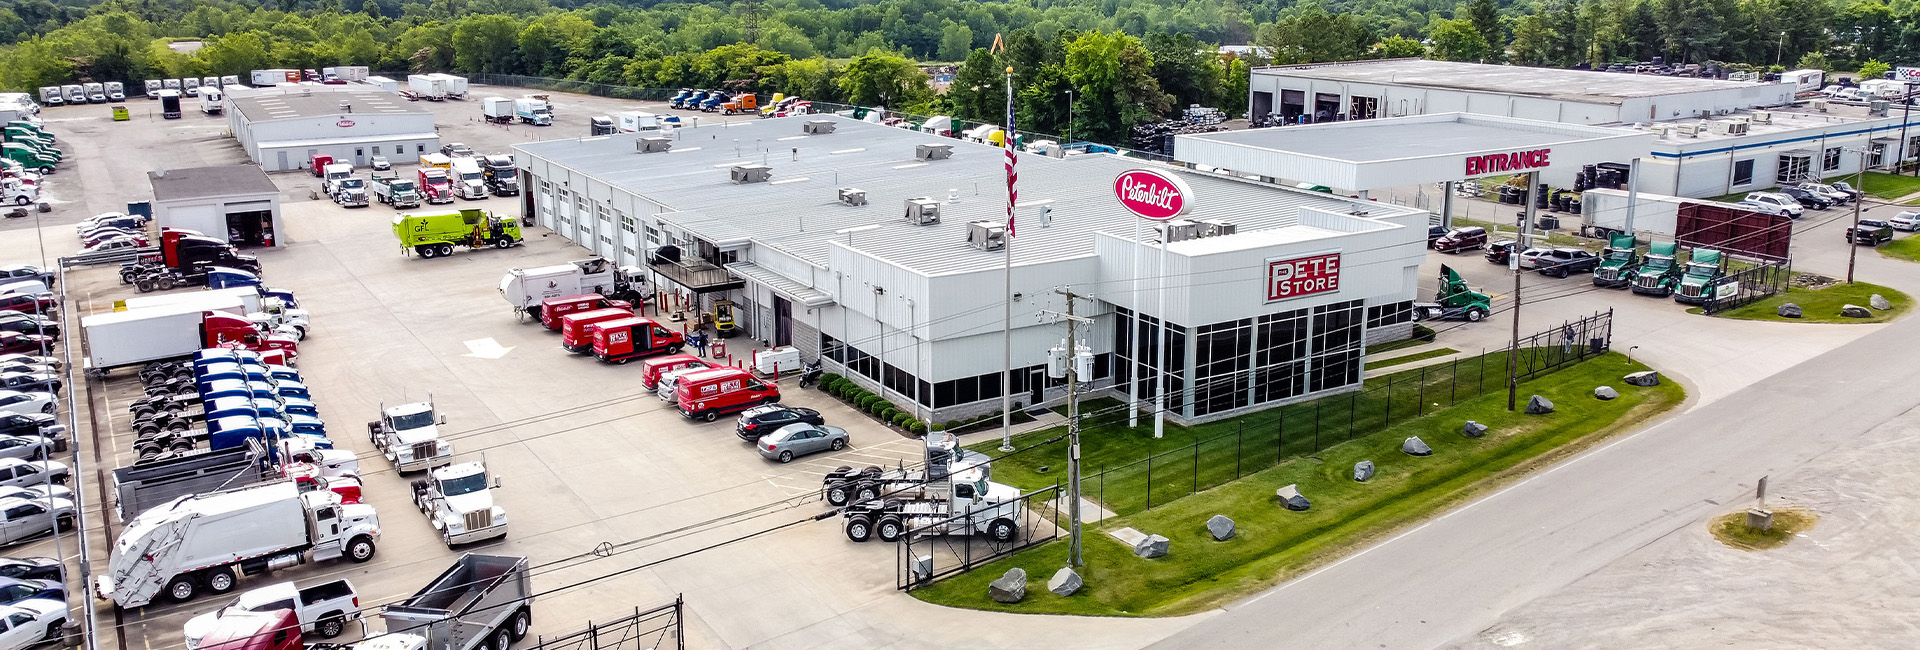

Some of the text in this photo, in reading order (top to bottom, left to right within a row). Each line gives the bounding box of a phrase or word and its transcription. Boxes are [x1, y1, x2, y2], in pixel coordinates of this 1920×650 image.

[1465, 149, 1551, 175] ENTRANCE
[1121, 174, 1179, 210] Peterbilt
[414, 219, 430, 232] GFL
[1270, 256, 1339, 298] PETE
[1280, 275, 1338, 296] STORE
